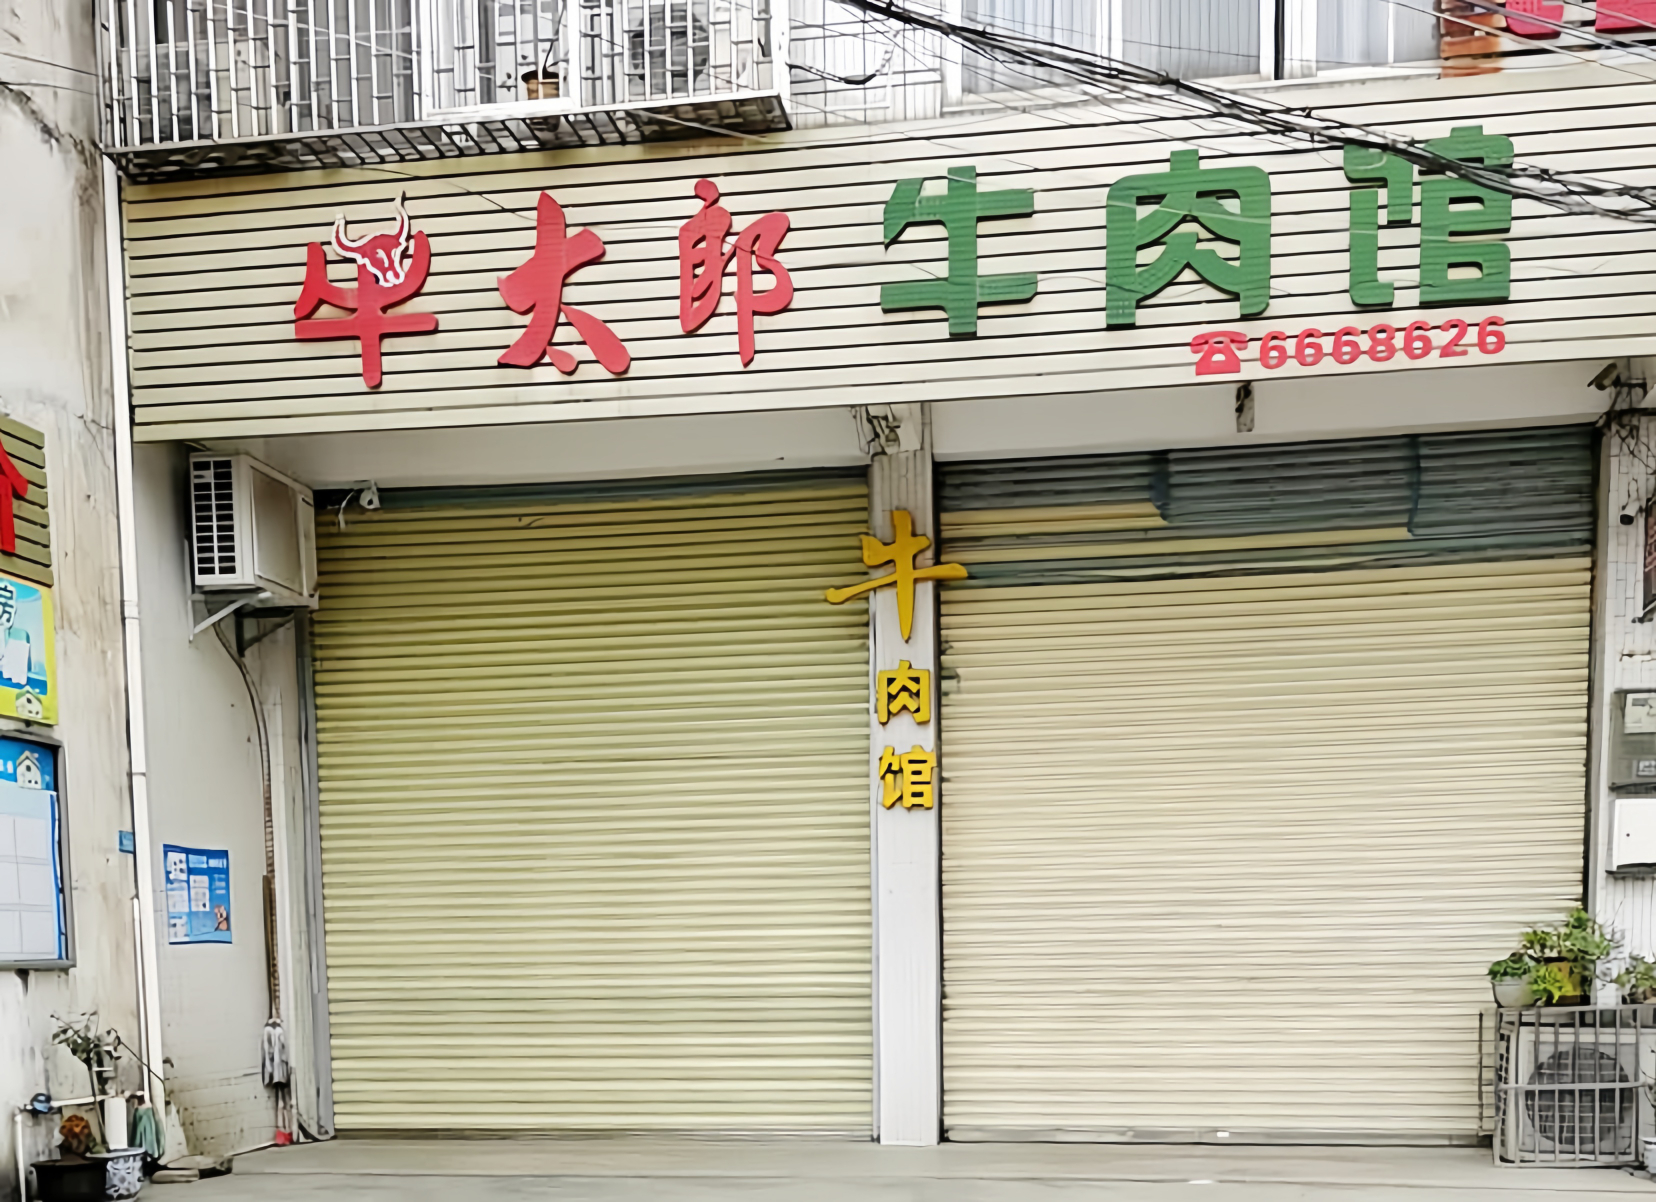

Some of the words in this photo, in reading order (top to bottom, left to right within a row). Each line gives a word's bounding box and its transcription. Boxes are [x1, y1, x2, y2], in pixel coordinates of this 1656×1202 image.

[880, 126, 1515, 337] 牛肉馆
[1258, 316, 1506, 370] 6668626
[825, 510, 968, 809] 牛肉馆
